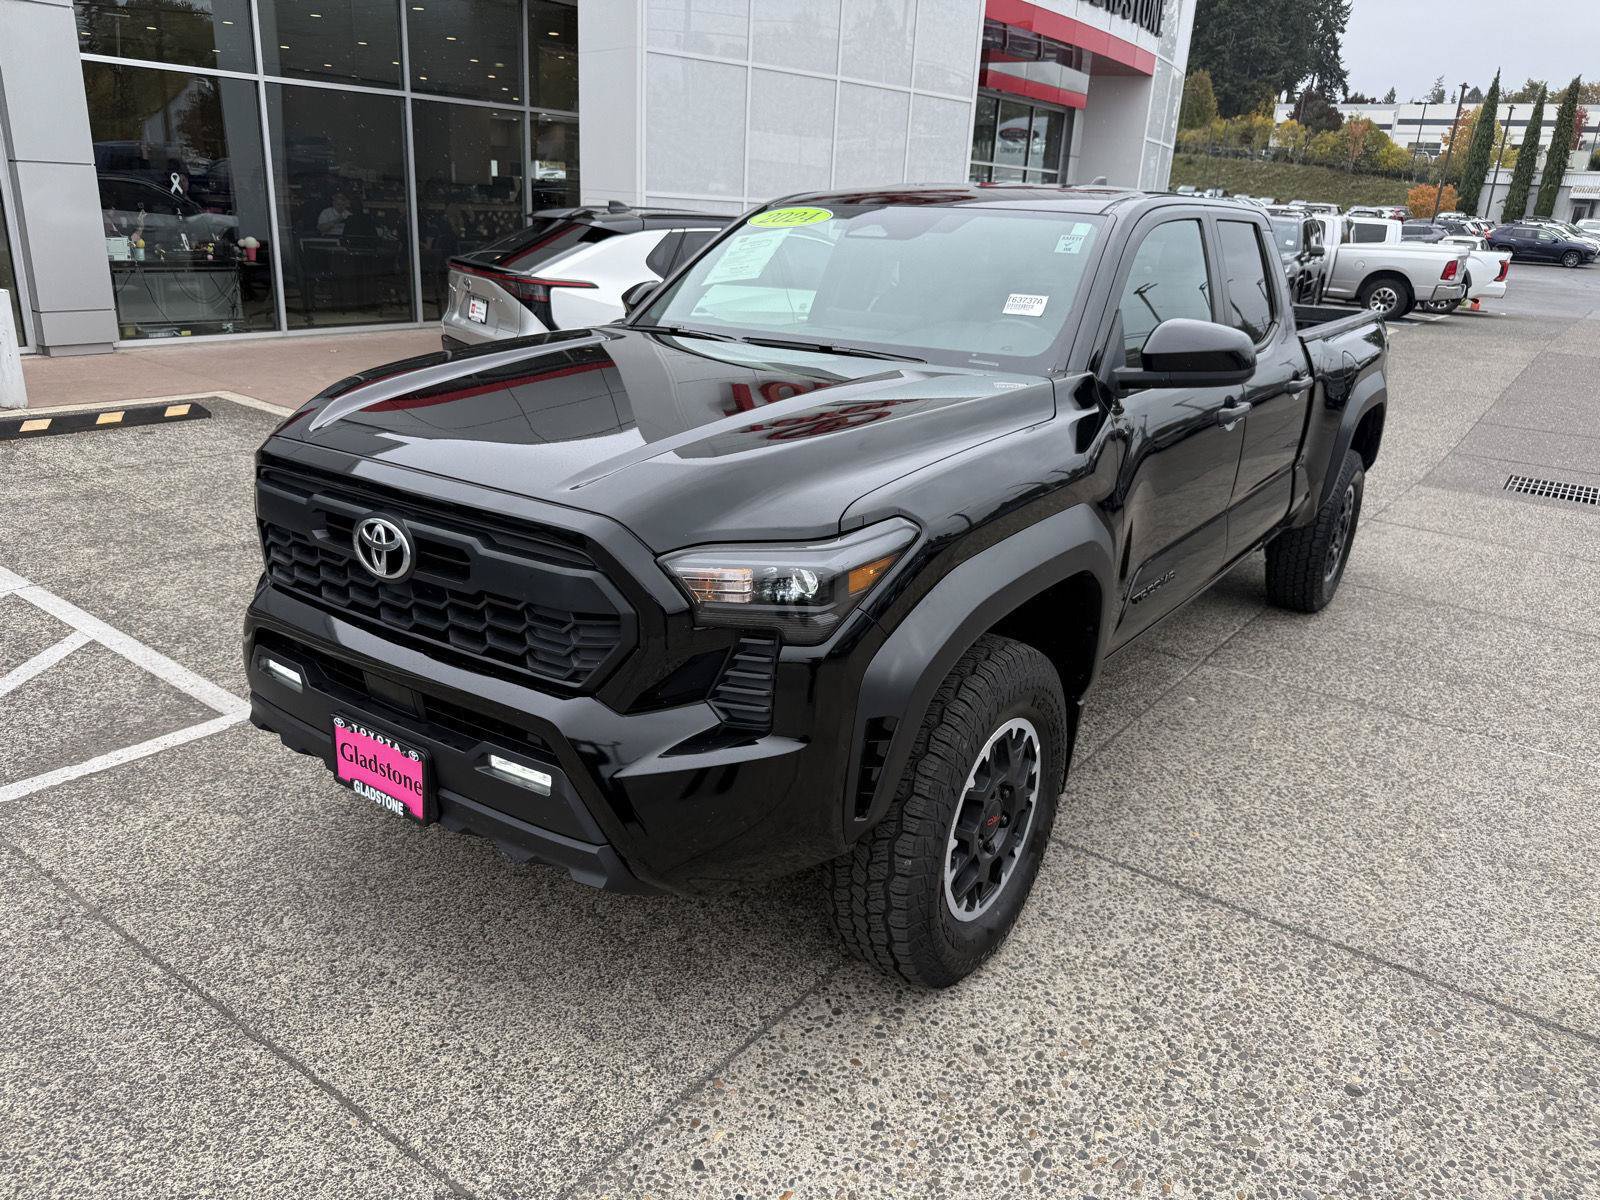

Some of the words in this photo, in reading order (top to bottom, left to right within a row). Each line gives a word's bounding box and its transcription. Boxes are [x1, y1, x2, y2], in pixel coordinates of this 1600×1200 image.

[351, 723, 401, 752] TOYOTA
[340, 742, 423, 796] Gladstone
[353, 779, 404, 816] GLADSTONE
